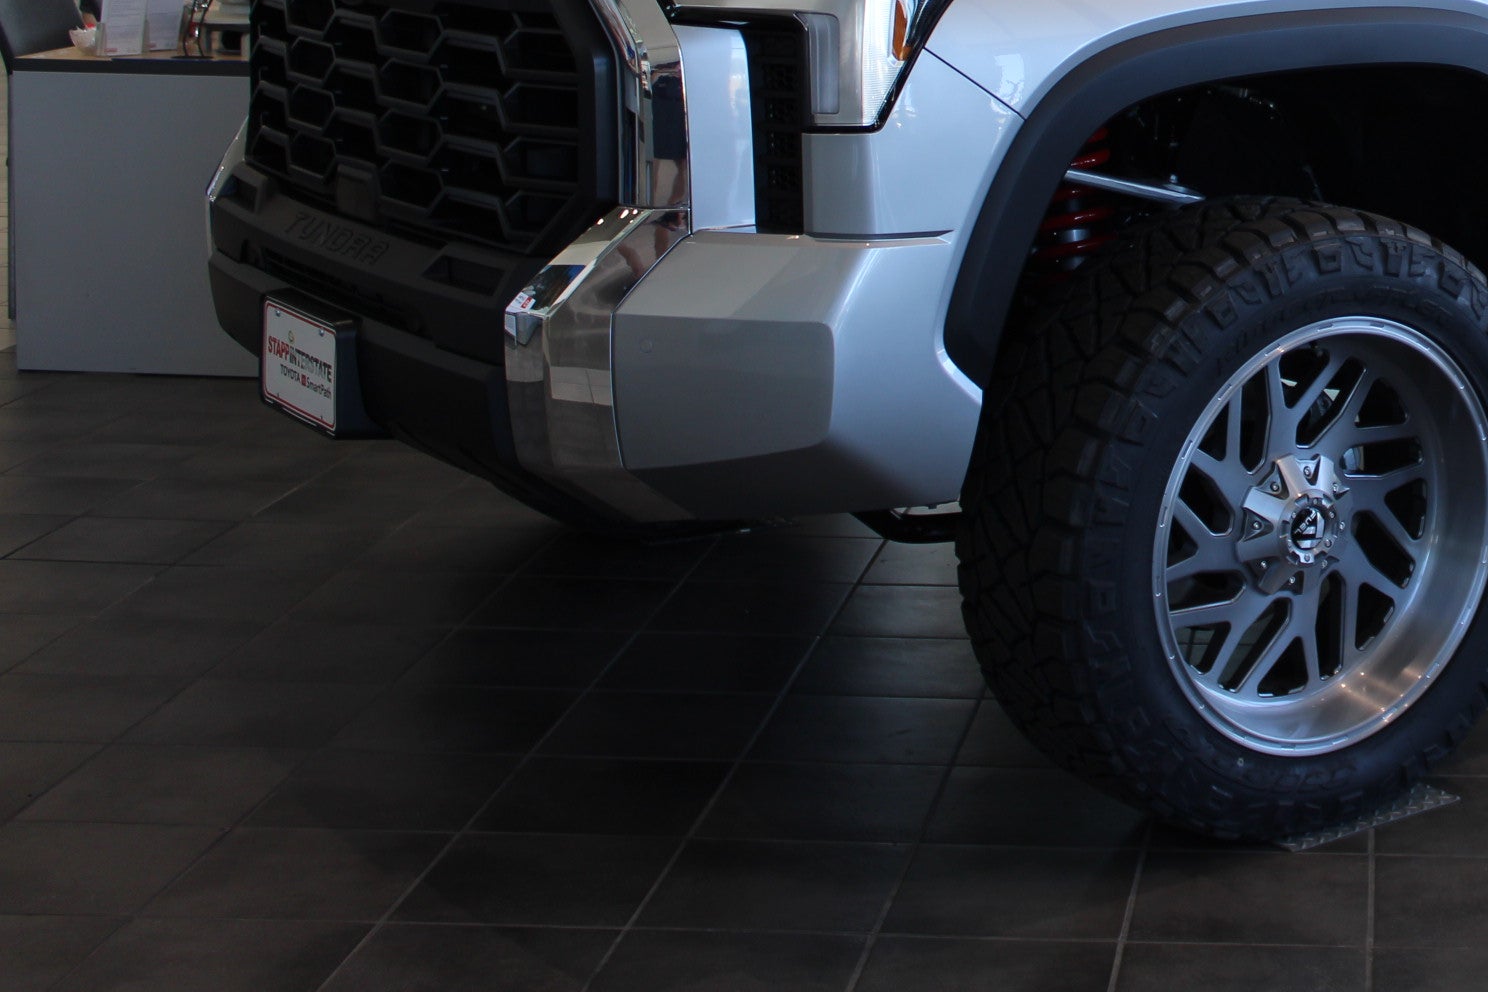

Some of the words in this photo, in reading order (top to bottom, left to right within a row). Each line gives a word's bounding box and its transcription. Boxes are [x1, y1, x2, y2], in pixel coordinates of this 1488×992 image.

[284, 212, 390, 265] TUNDRA
[268, 335, 290, 361] STAPP
[289, 345, 332, 384] INTERSTATE
[280, 363, 301, 383] TOYOTA
